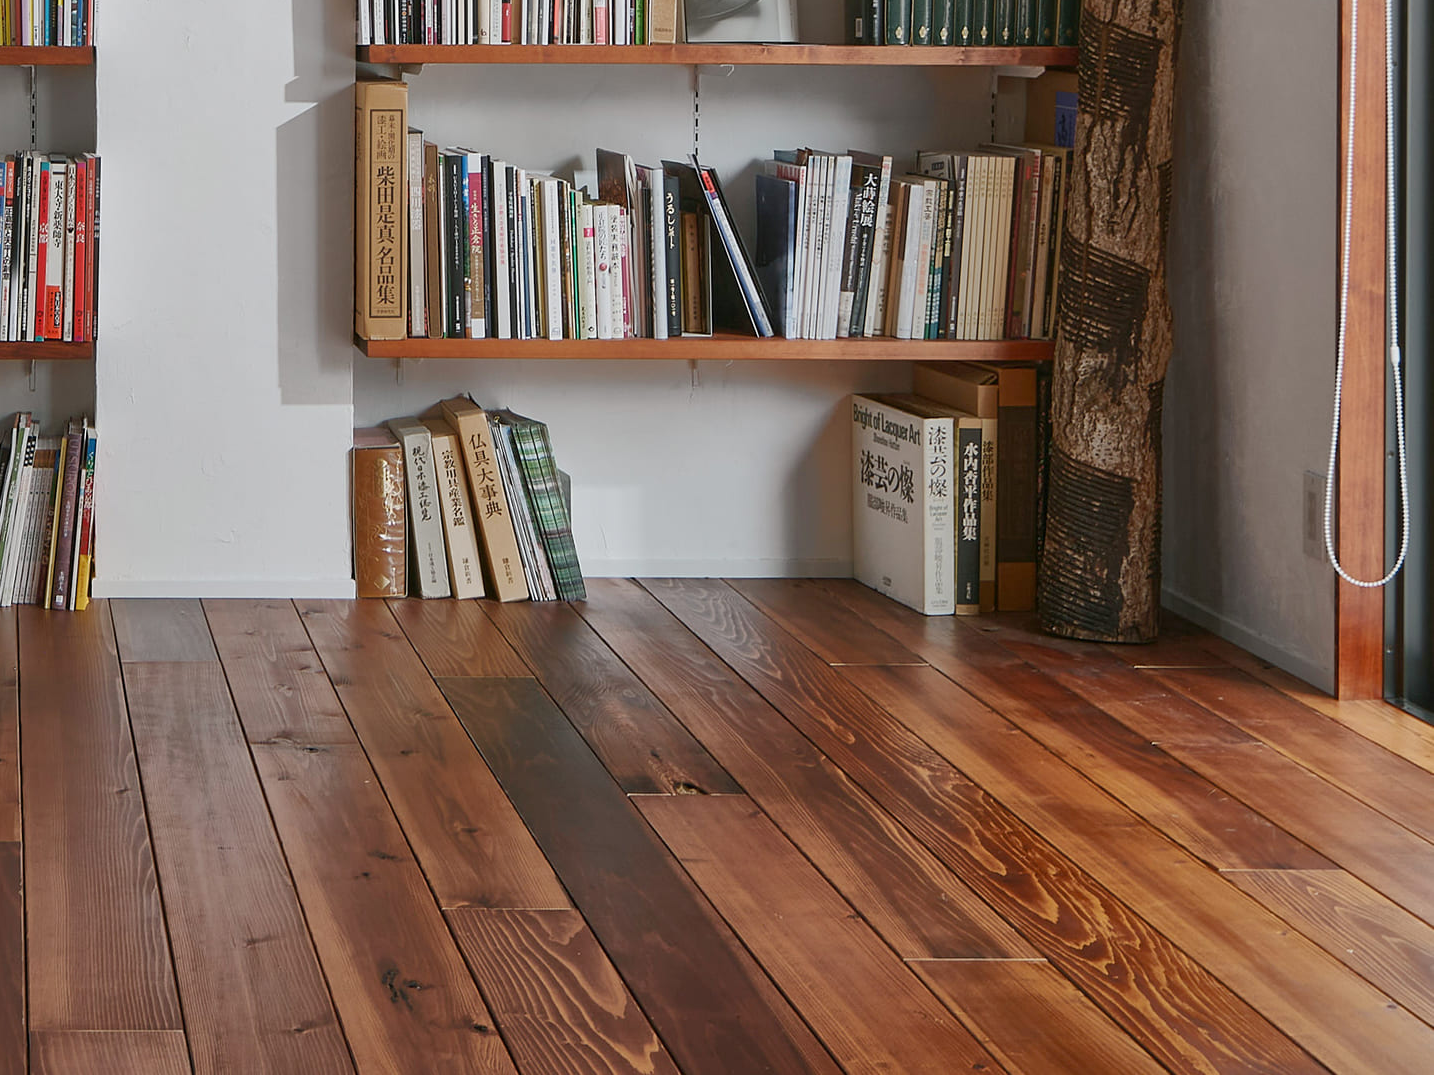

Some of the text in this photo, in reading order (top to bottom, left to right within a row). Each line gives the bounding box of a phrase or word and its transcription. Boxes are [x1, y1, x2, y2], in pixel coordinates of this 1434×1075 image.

[376, 115, 387, 160] 漆工・絵画
[860, 172, 879, 228] 大蒔絵展
[854, 403, 921, 446] Bright of Lacquer Art
[441, 451, 466, 527] 宗教用具産業名鑑
[469, 434, 503, 520] 仏具大事典
[860, 449, 914, 504] 漆芸の燦
[928, 426, 948, 498] 漆芸の燦
